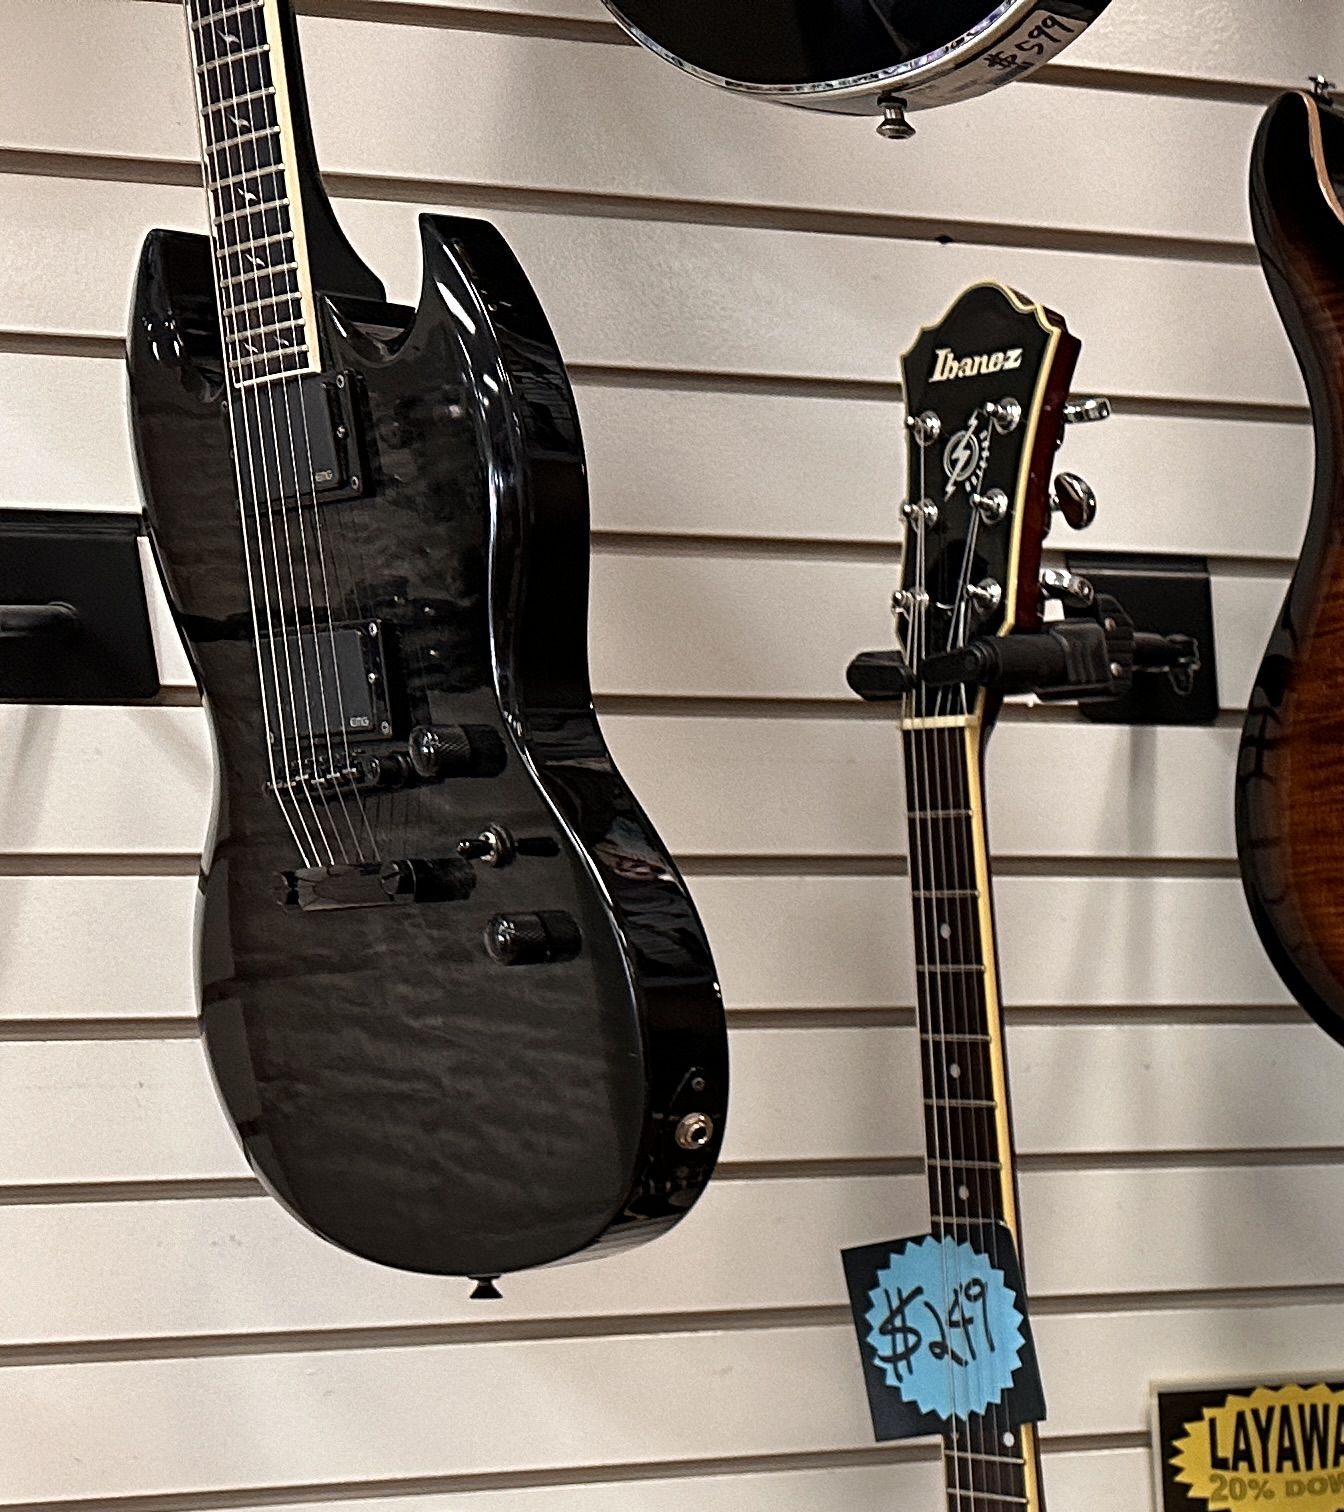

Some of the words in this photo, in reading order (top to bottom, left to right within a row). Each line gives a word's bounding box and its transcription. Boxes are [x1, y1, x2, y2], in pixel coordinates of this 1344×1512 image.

[928, 347, 1024, 383] Ibanez
[877, 1277, 996, 1384] $249
[1209, 1473, 1277, 1501] 20%
